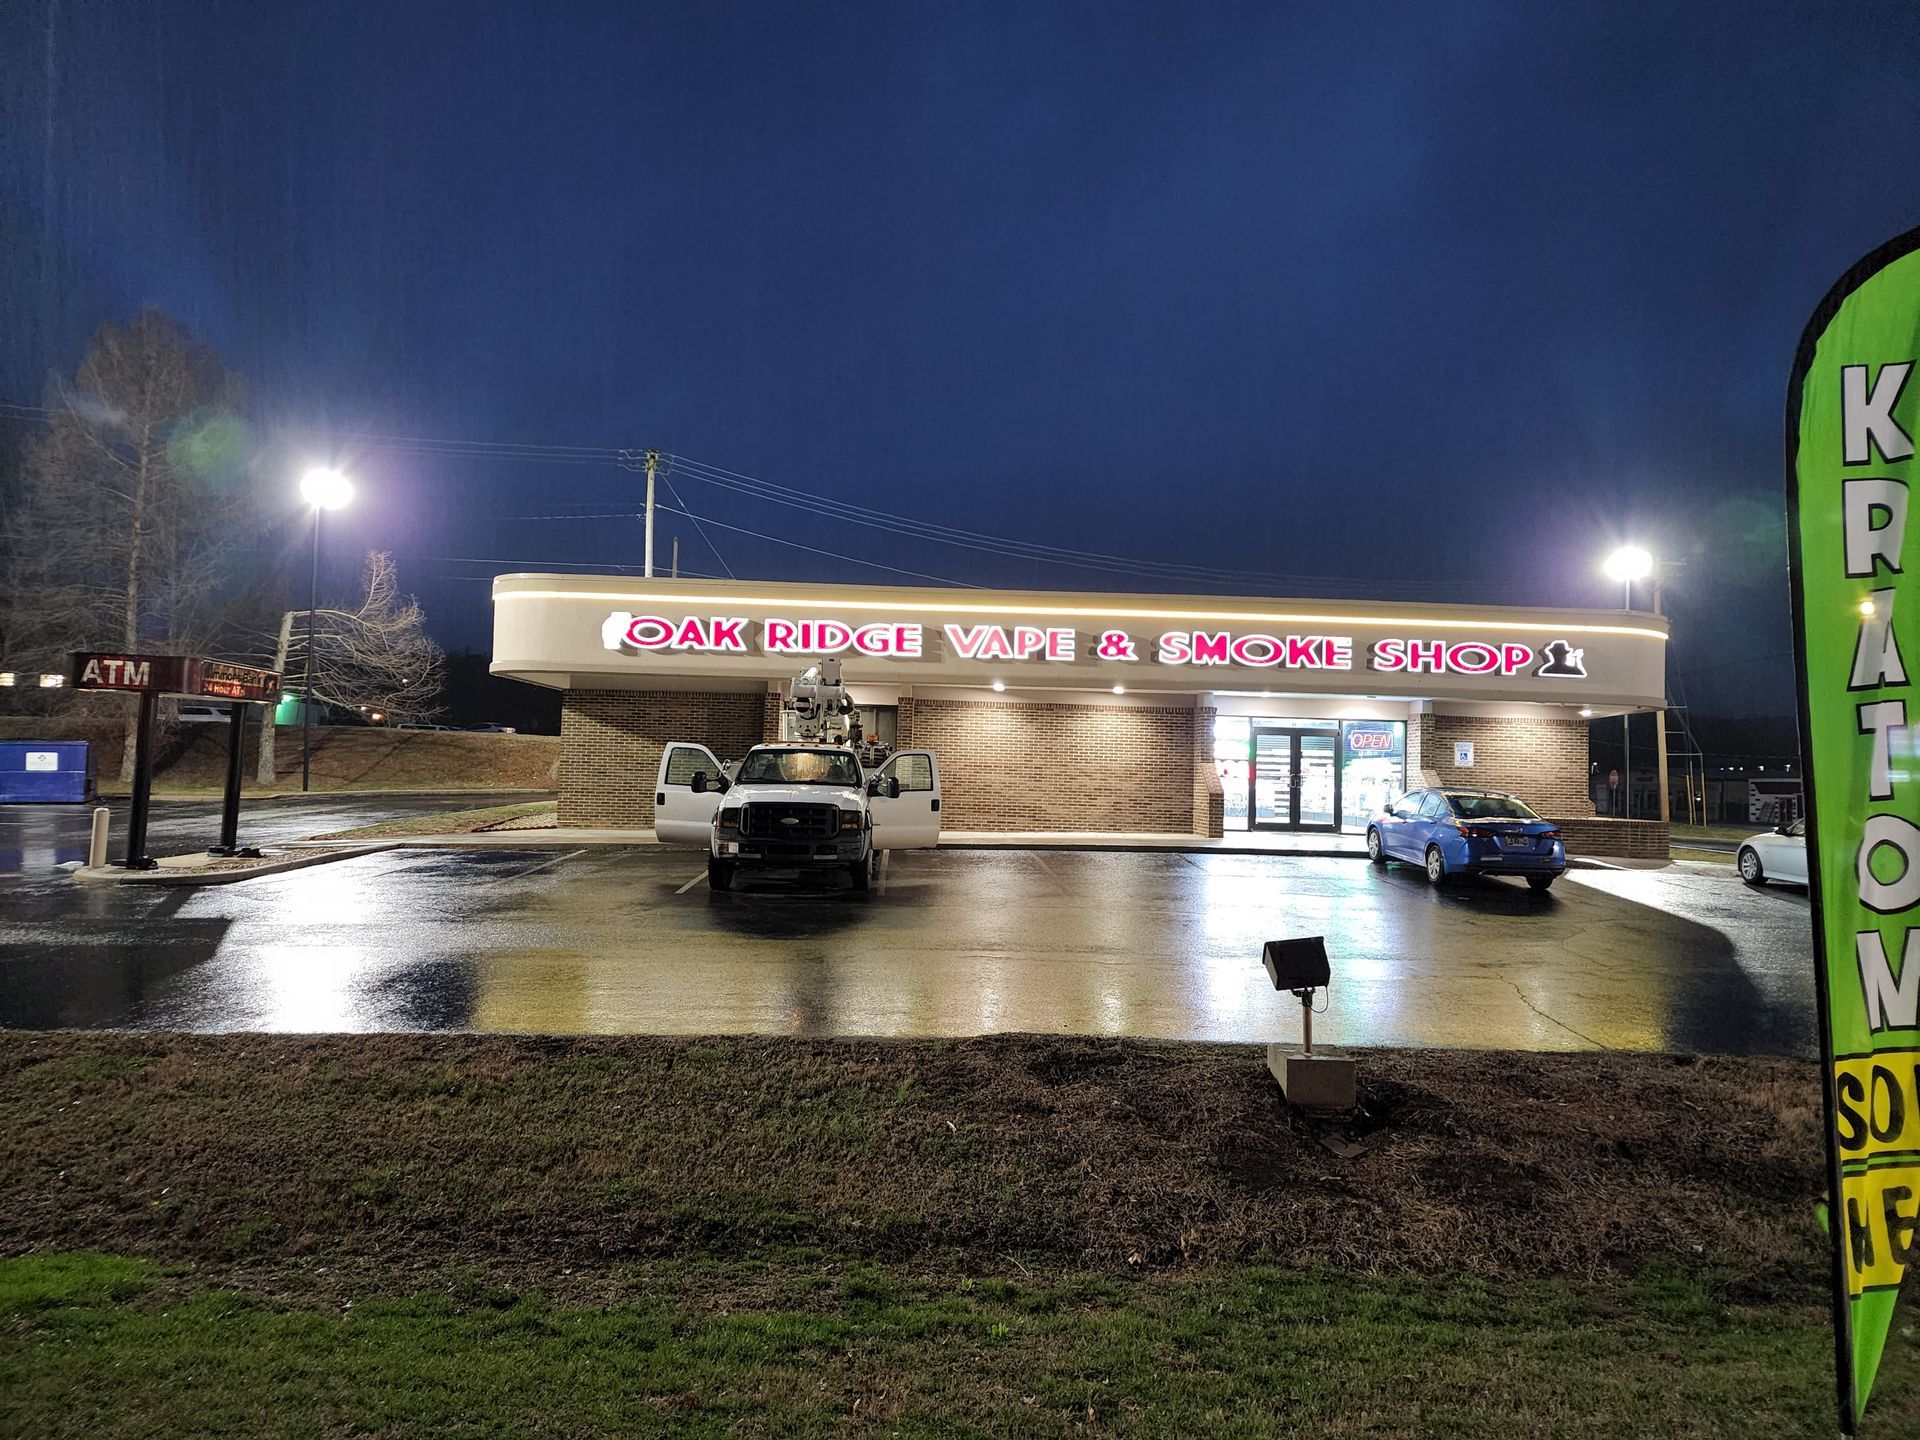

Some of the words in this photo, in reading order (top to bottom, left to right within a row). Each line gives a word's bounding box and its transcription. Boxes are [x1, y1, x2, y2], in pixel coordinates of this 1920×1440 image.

[623, 615, 749, 651] OAK
[764, 618, 922, 657] RIDGE
[944, 624, 1075, 661] VAPE
[1097, 630, 1139, 661] &
[1158, 631, 1352, 670] SMOKE
[1373, 639, 1533, 676] SHOP
[80, 659, 150, 685] ATM
[214, 684, 231, 694] Hour
[1353, 733, 1392, 748] OPEN
[1837, 1064, 1920, 1151] SO
